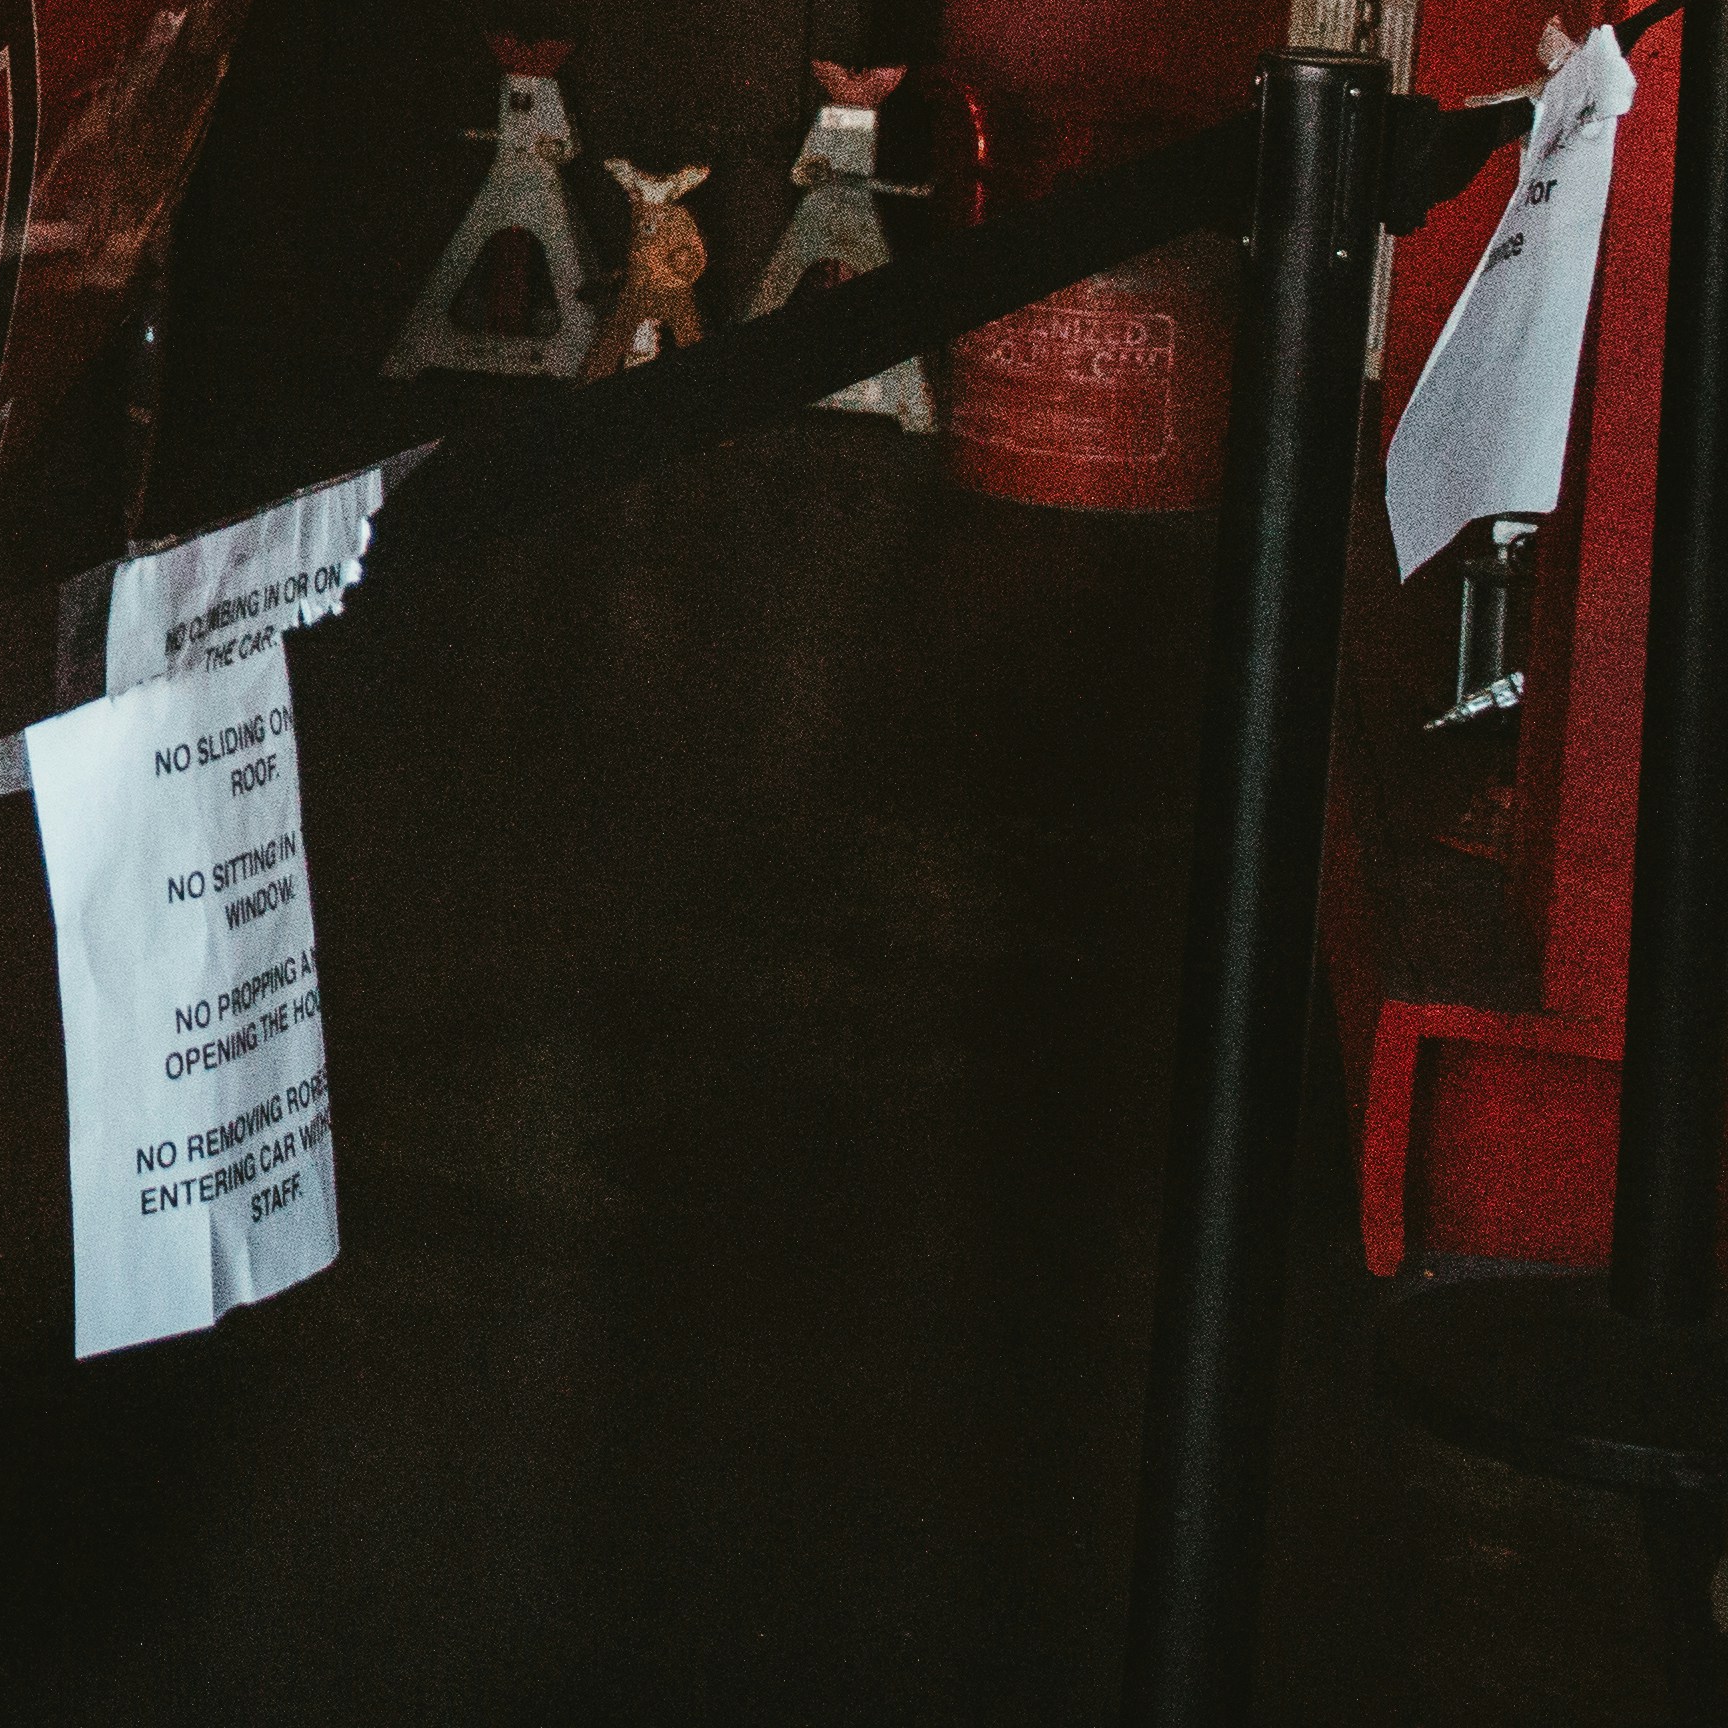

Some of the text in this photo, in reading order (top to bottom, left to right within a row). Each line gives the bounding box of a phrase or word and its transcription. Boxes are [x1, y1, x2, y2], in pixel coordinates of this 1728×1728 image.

[263, 580, 280, 612] IN
[284, 572, 309, 603] OR
[315, 562, 342, 594] ON
[205, 638, 236, 673] THE
[155, 744, 190, 777] NO
[198, 716, 265, 762] SLIDING
[167, 830, 296, 904] NO SITTING IN
[175, 999, 211, 1034] NO
[217, 957, 297, 1020] PROPPING
[165, 1024, 258, 1081] OPENING
[260, 1003, 288, 1039] THE
[136, 1141, 177, 1174] NO
[187, 1095, 282, 1161] REMOVING
[140, 1154, 256, 1216] ENTERING
[260, 1132, 296, 1173] CAR
